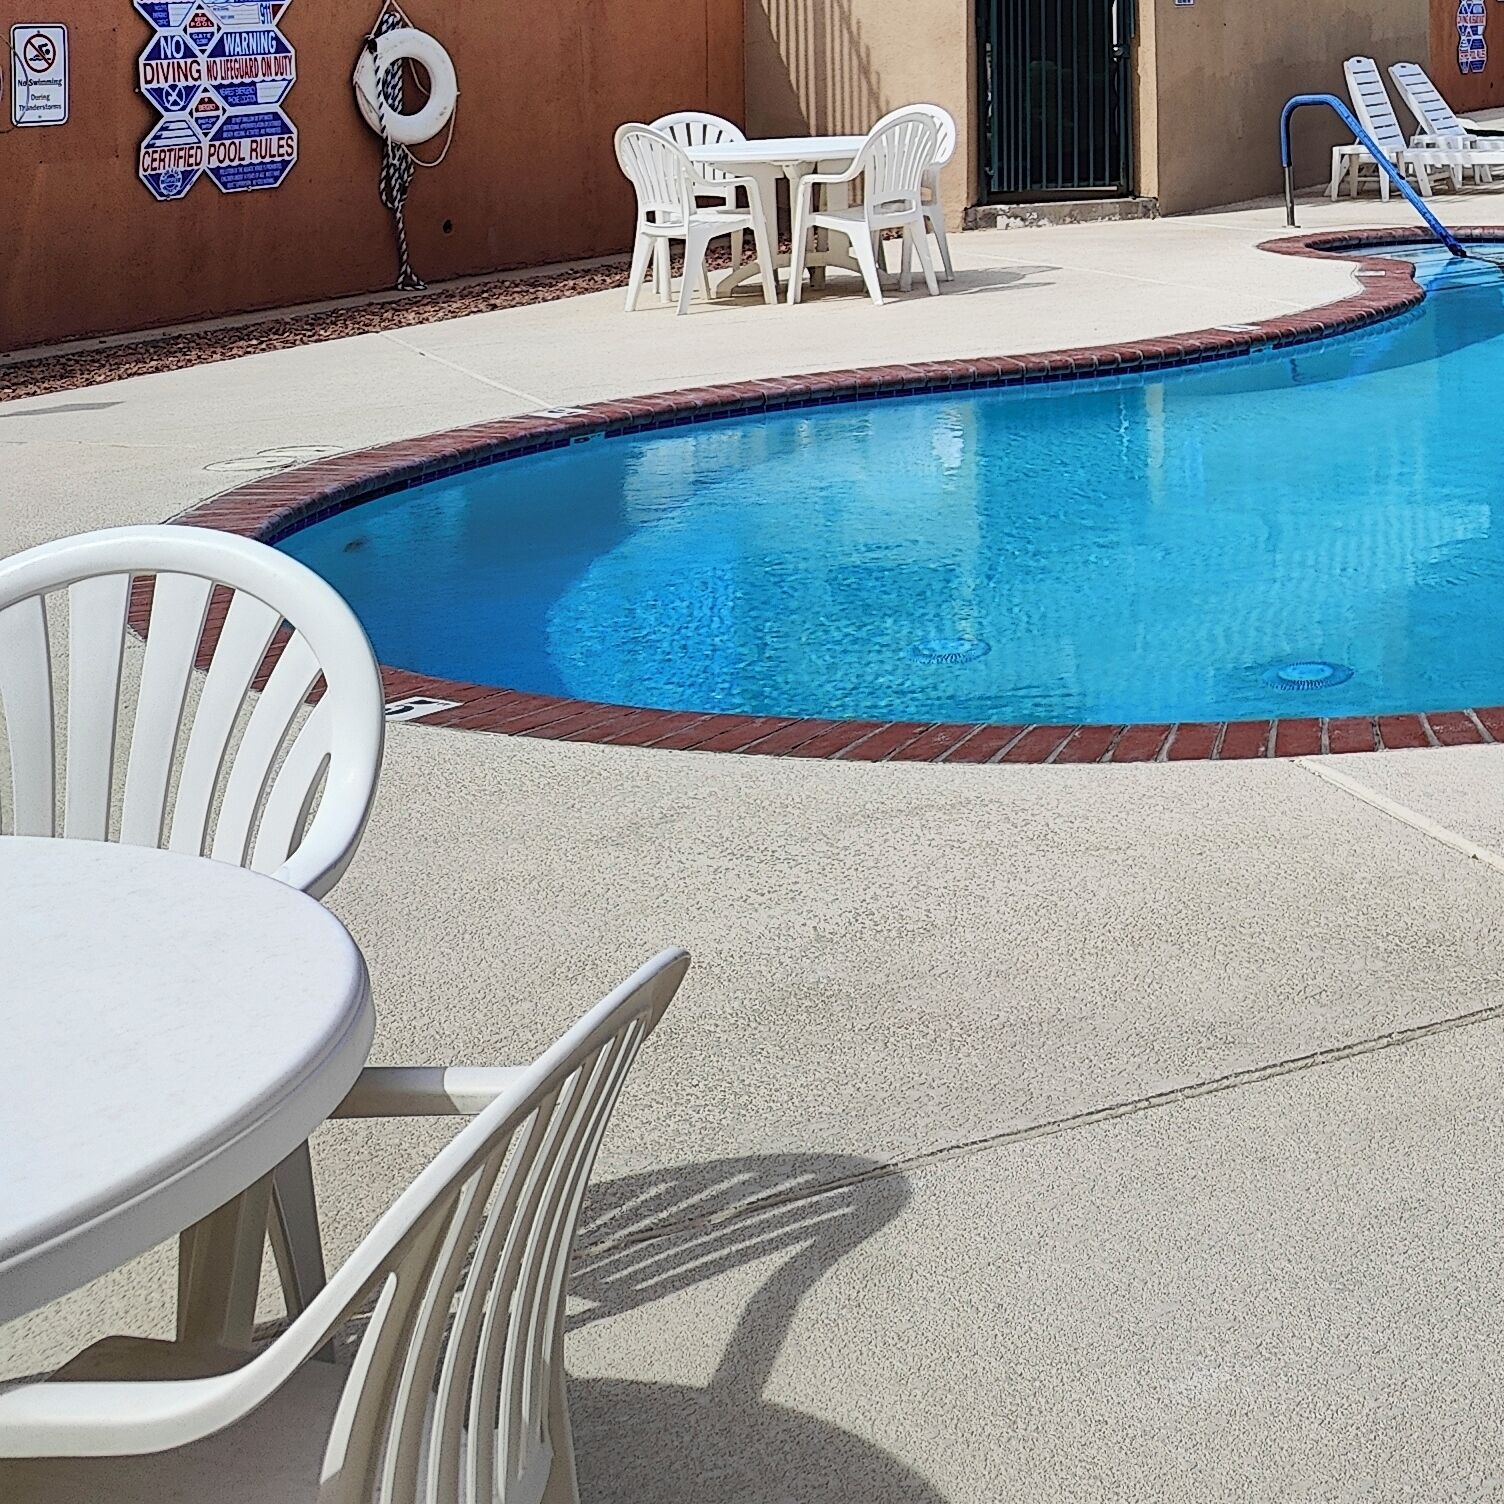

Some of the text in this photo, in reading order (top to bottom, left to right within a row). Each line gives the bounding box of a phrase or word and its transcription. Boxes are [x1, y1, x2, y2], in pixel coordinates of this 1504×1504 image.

[259, 3, 273, 25] 911
[159, 35, 185, 59] NO
[223, 31, 277, 56] WARNING
[143, 59, 202, 84] DIVING
[206, 55, 293, 82] NO LIFEGUARD ON DUTY
[18, 77, 63, 87] No Swimming
[31, 93, 51, 102] During
[142, 145, 203, 173] CERTIFIED
[207, 135, 295, 165] POOL RULES
